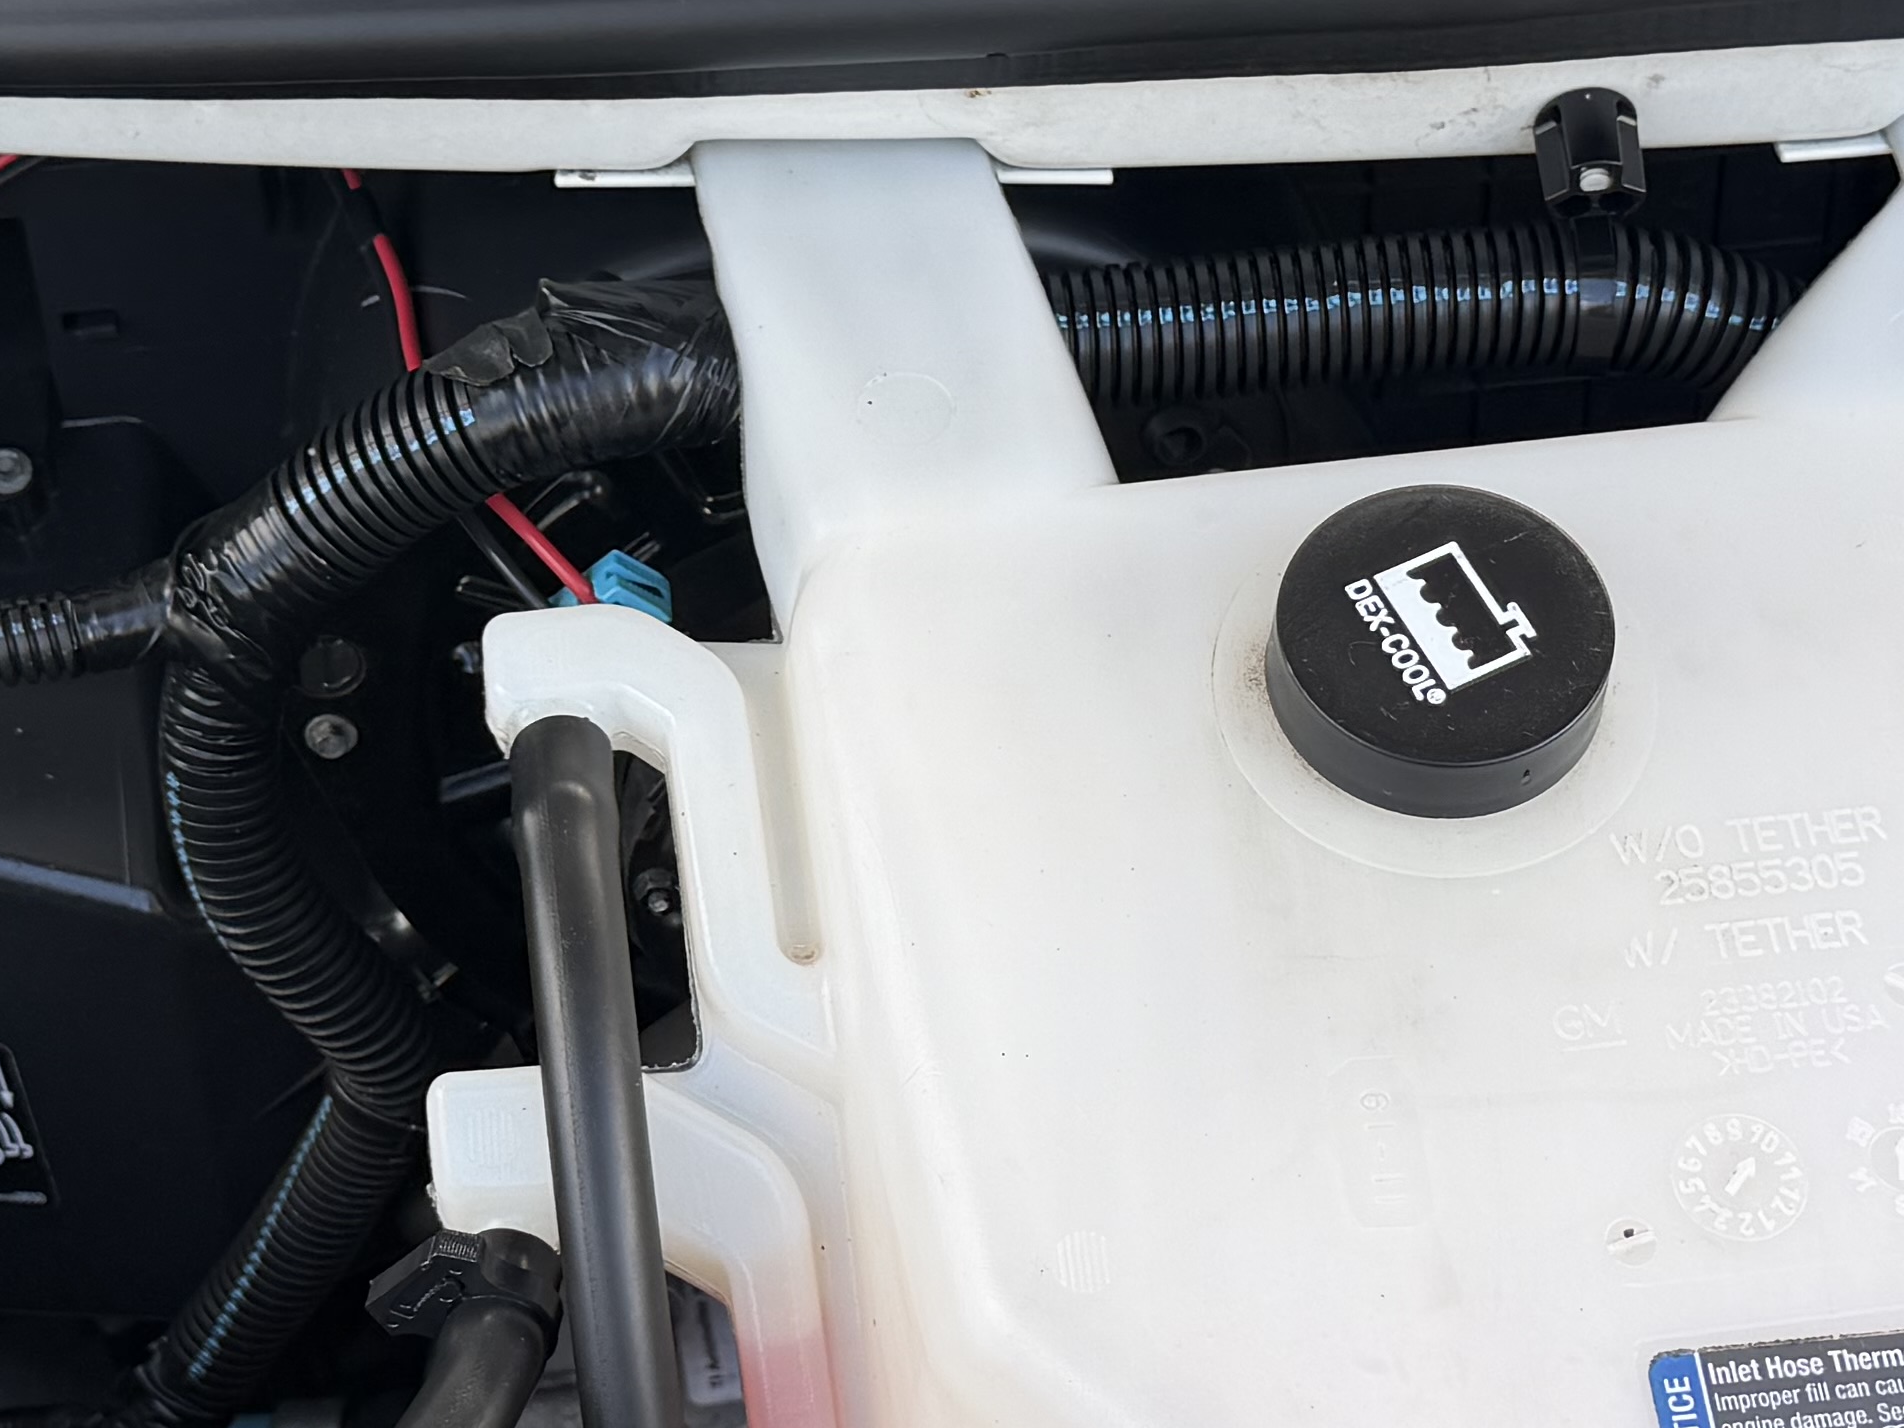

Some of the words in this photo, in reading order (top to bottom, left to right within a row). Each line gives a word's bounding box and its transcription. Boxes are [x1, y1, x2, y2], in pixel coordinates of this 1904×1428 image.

[1610, 824, 1703, 866] W/O
[1726, 806, 1887, 856] TETHER
[1654, 852, 1865, 906] 25855305
[1624, 928, 1677, 969] W/
[1705, 909, 1869, 960] TETHER
[1773, 1012, 1809, 1040] IN
[1821, 1005, 1890, 1034] USA
[1708, 1359, 1761, 1385] Inlet
[1766, 1353, 1823, 1379] Hose
[1714, 1386, 1801, 1413] Improper
[1805, 1380, 1830, 1402] fill
[1835, 1380, 1870, 1400] can
